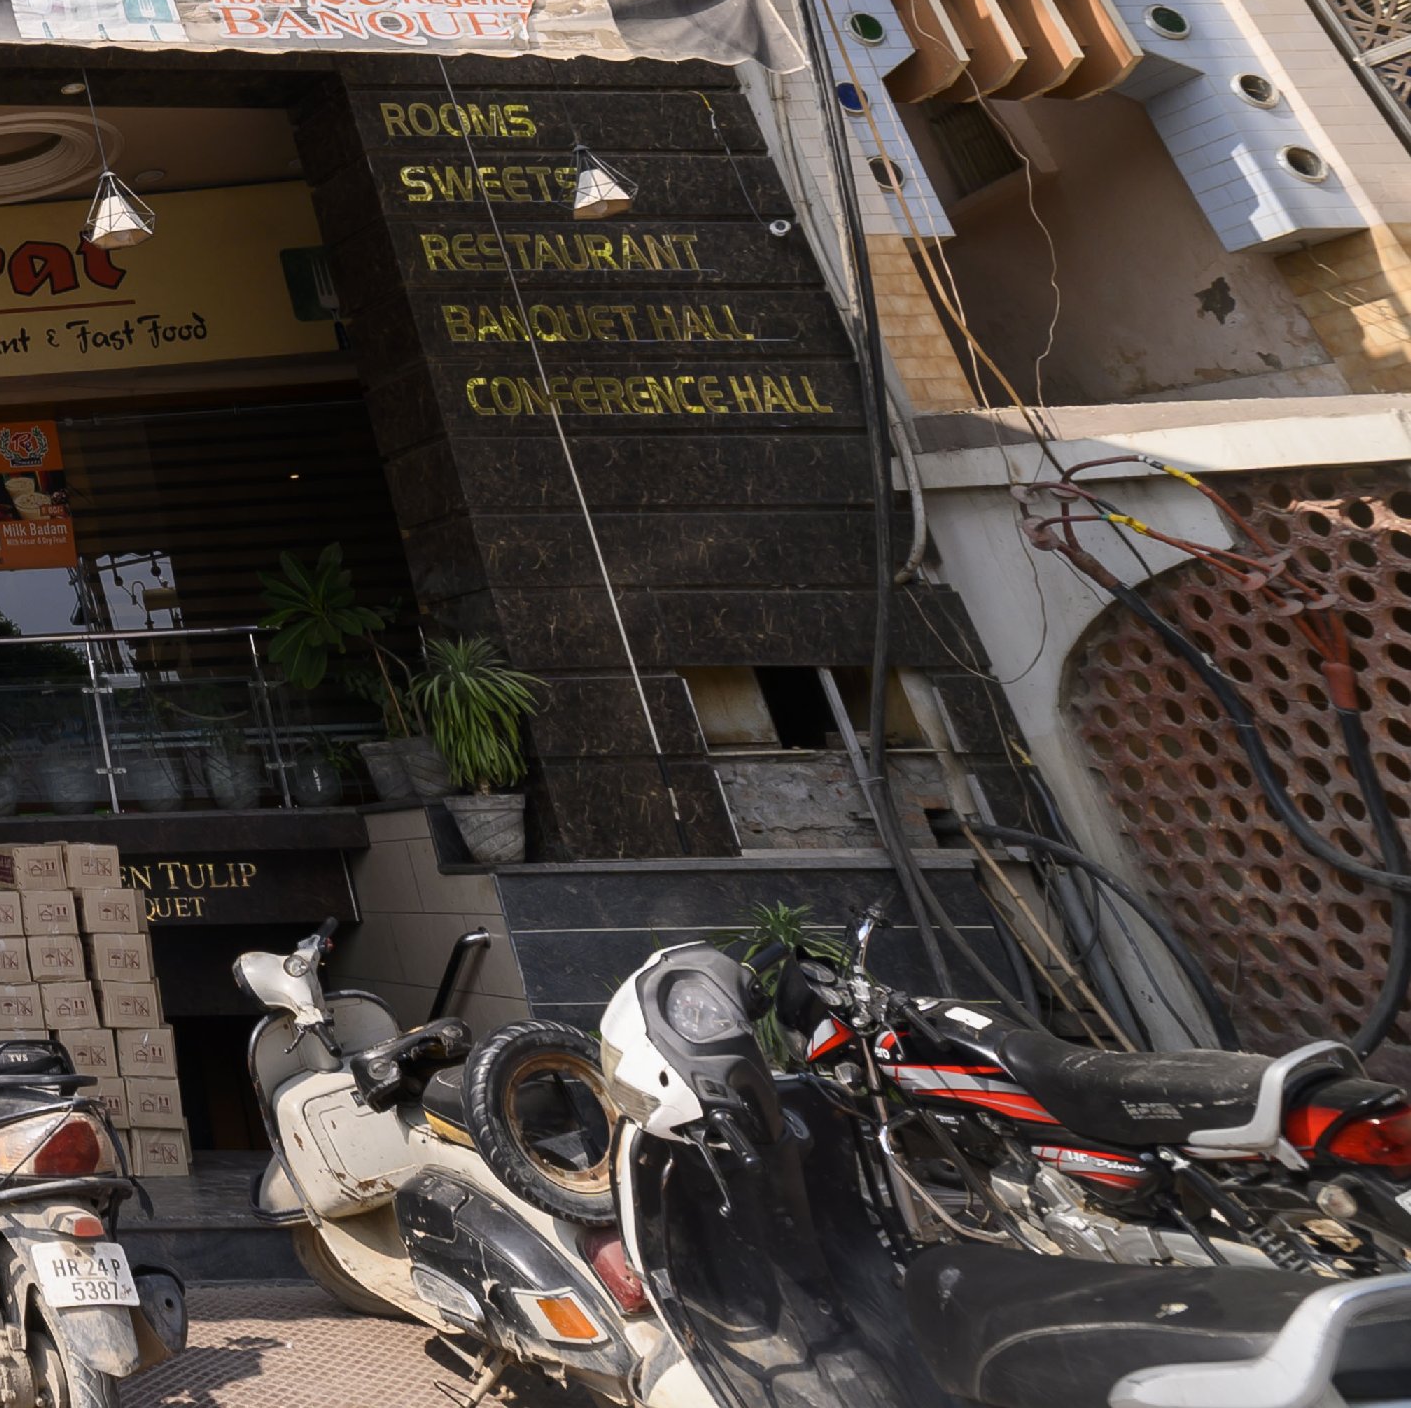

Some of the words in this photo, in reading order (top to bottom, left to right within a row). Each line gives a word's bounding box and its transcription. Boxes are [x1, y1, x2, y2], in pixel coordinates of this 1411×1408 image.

[380, 102, 537, 138] ROOMS
[400, 165, 578, 203] SWEETS
[420, 233, 700, 271] RESTAURANT
[66, 318, 135, 355] Fast
[138, 311, 208, 345] Food
[442, 304, 639, 342] BANQUET
[648, 304, 755, 342] HALL
[466, 376, 728, 415] CONFERENCE
[730, 375, 834, 414] HALL
[2, 523, 27, 538] Milk
[29, 522, 68, 536] Badam
[155, 862, 258, 890] TULIP
[144, 896, 207, 923] QUET
[9, 1053, 29, 1063] TVS
[51, 1259, 81, 1278] HR
[87, 1258, 110, 1278] 24
[111, 1258, 121, 1279] P
[72, 1281, 119, 1301] 5387
